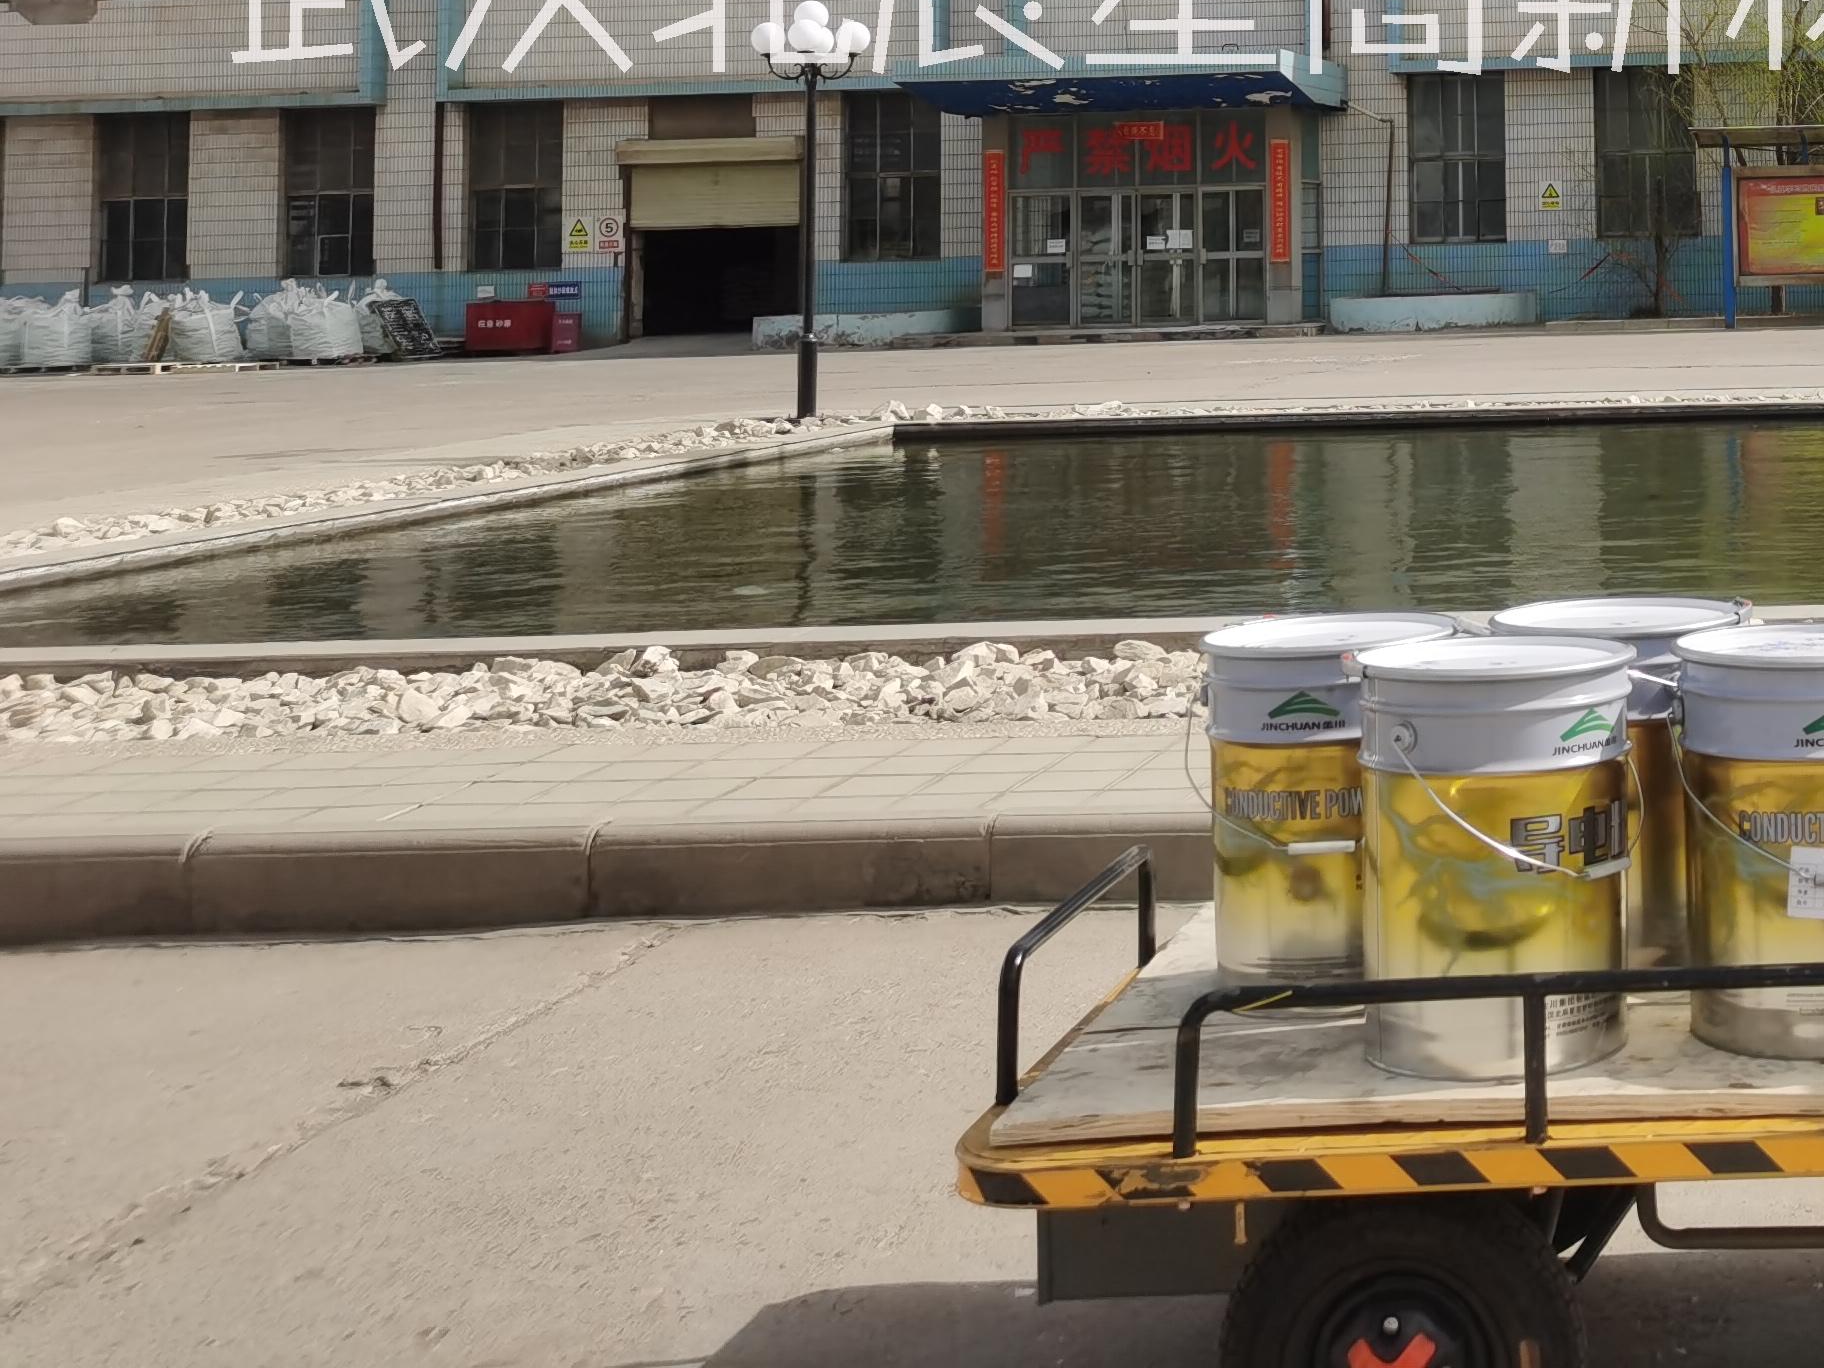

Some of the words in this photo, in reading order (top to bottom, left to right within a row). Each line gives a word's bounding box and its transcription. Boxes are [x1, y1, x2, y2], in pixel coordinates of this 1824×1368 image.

[1019, 120, 1256, 176] 严禁烟火
[605, 223, 613, 233] 5
[1261, 722, 1321, 731] JINCHUAN
[1552, 740, 1604, 756] JINCHUAN
[1325, 786, 1364, 820] POW
